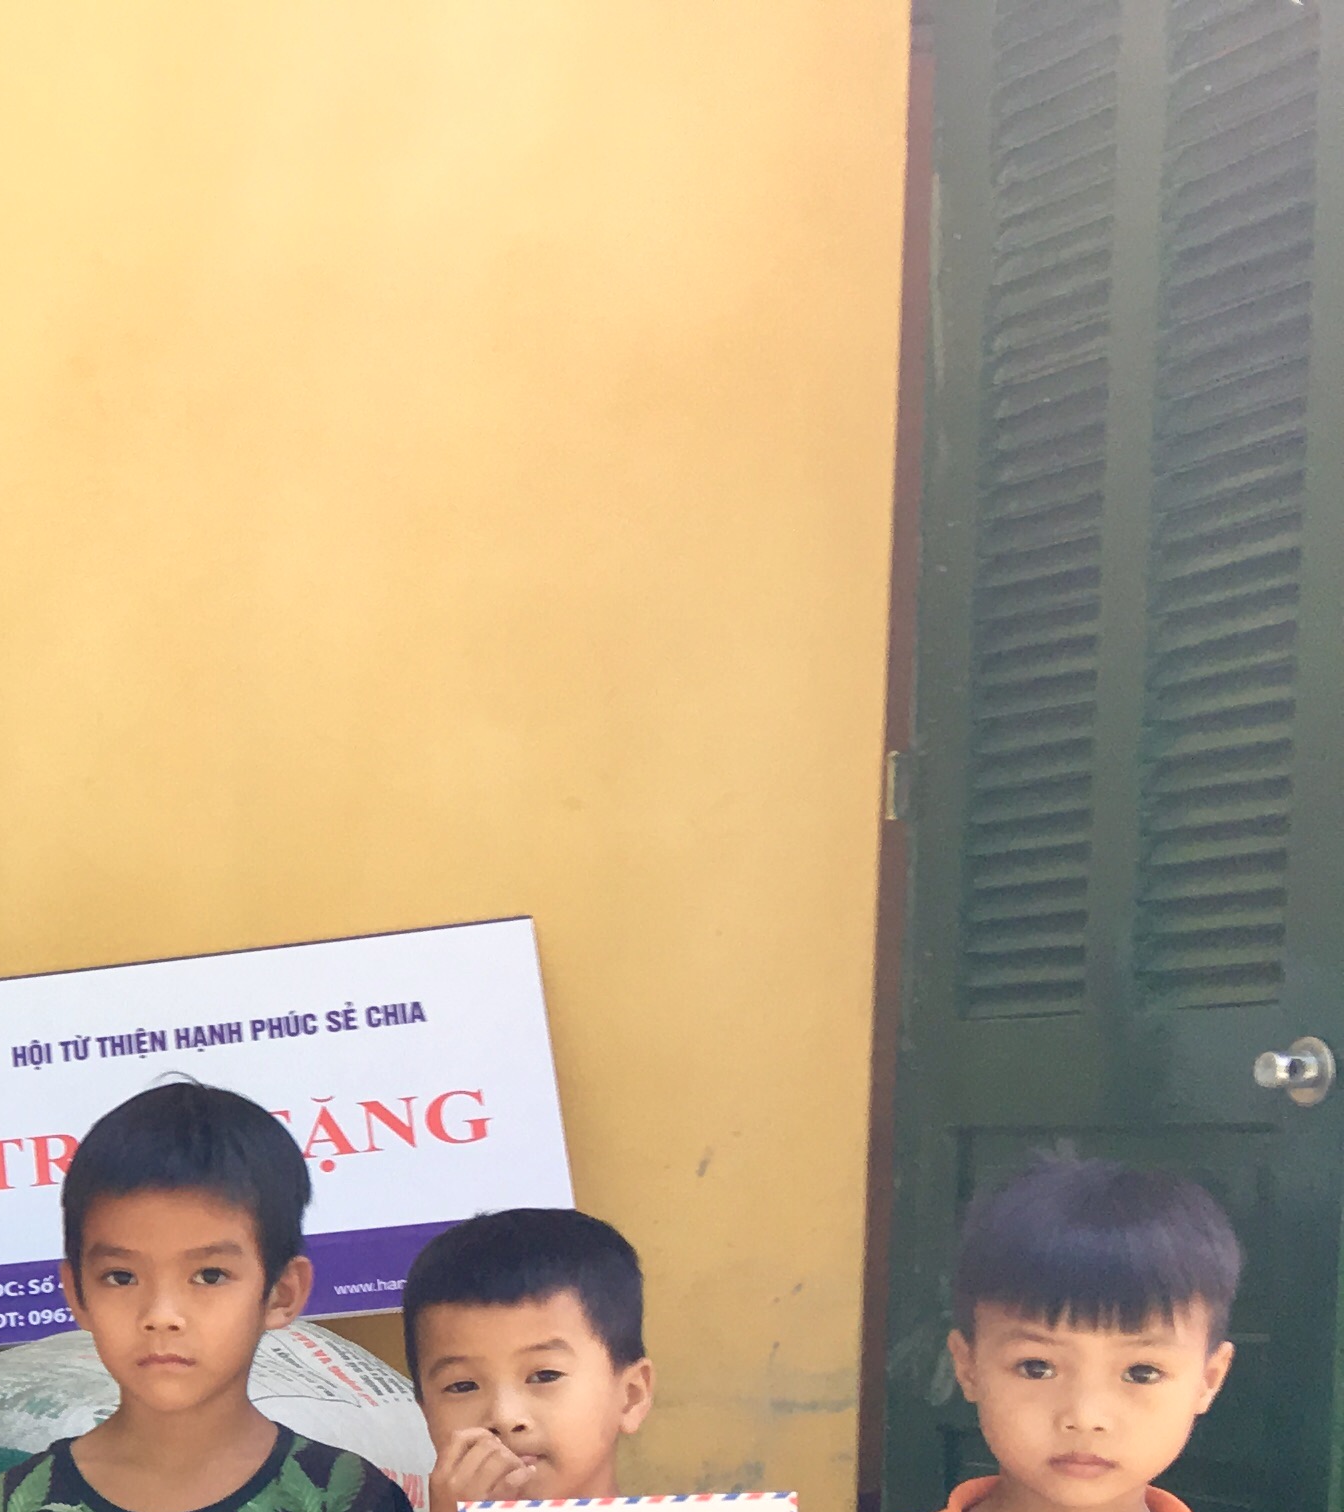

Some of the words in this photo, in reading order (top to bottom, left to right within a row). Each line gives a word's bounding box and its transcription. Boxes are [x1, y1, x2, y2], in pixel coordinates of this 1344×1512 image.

[11, 1039, 52, 1070] HỘI
[60, 1034, 91, 1062] TỪ
[96, 1028, 168, 1058] THIỆN
[175, 1021, 243, 1052] HẠNH
[250, 1009, 318, 1040] PHÚC
[325, 1001, 359, 1032] SẺ
[365, 1001, 428, 1028] CHIA
[269, 1089, 493, 1173] ẶNG
[28, 1275, 54, 1296] Số
